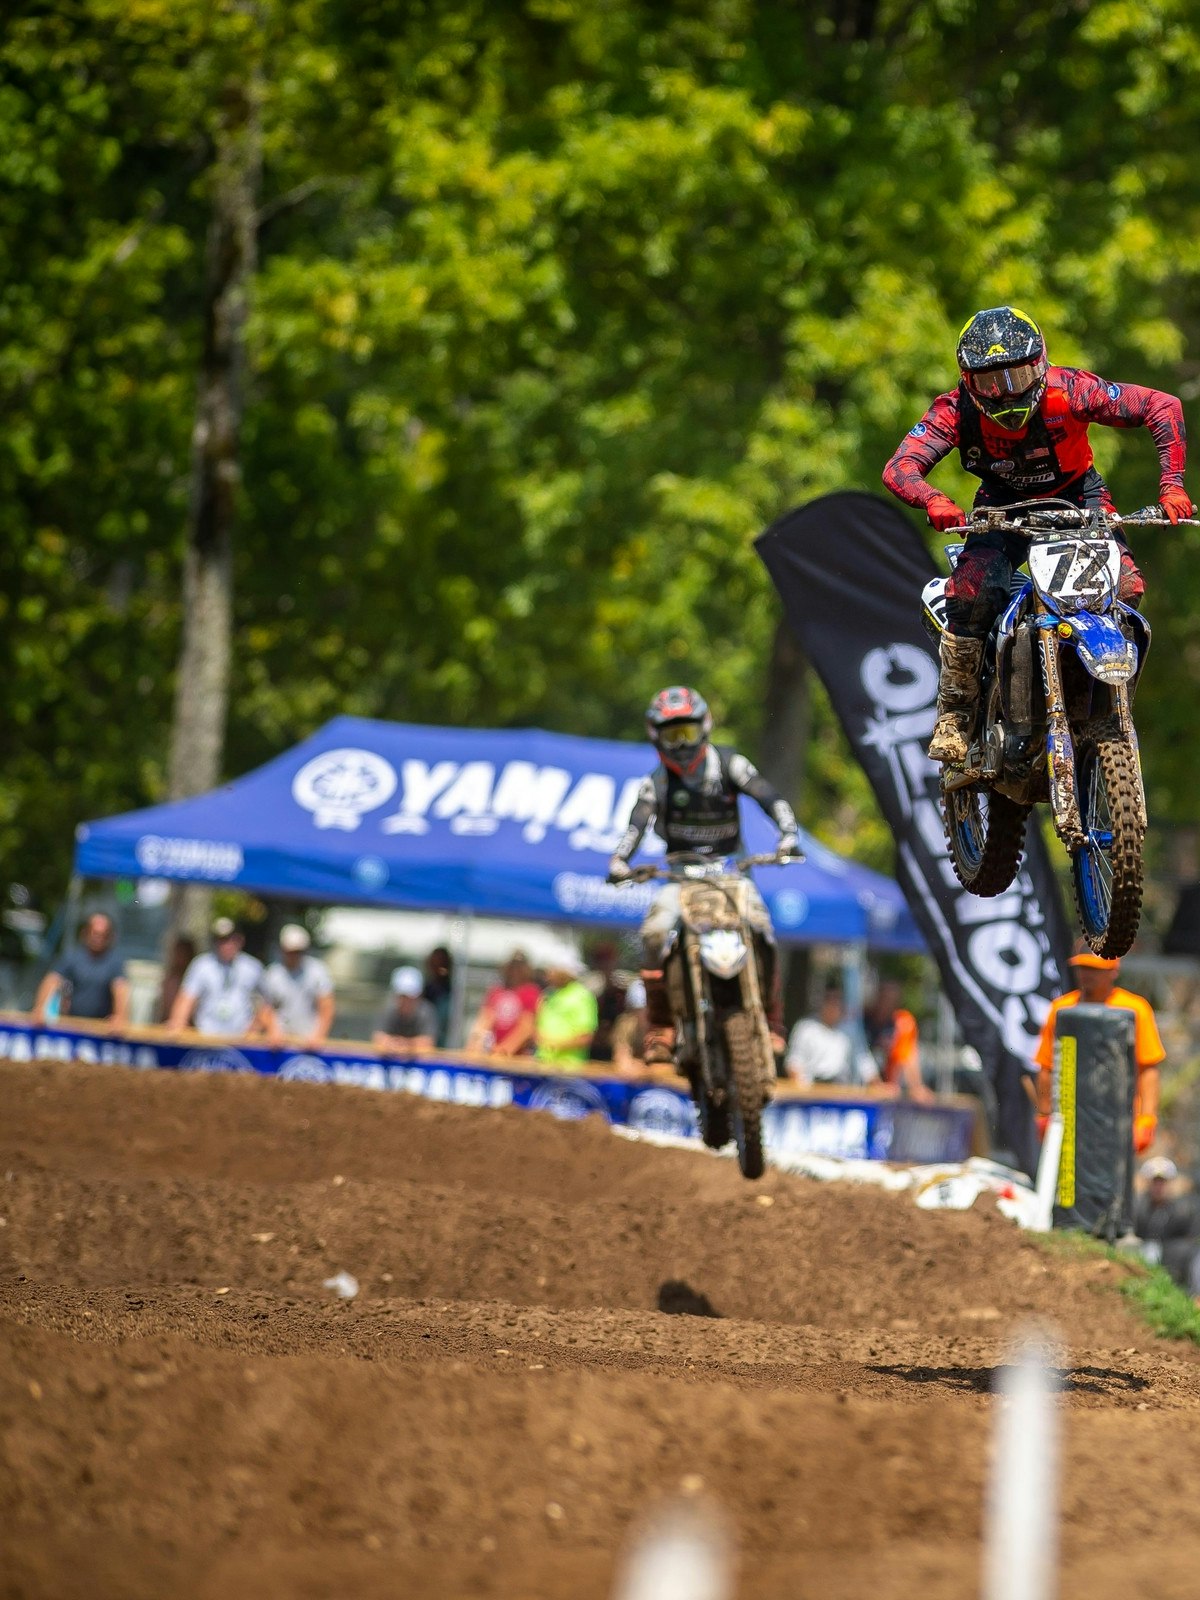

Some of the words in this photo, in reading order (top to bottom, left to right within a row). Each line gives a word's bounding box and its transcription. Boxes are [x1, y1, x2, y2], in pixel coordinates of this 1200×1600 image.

[1047, 542, 1111, 592] 72
[1106, 670, 1129, 678] YAMAHA
[401, 759, 652, 836] YAMA
